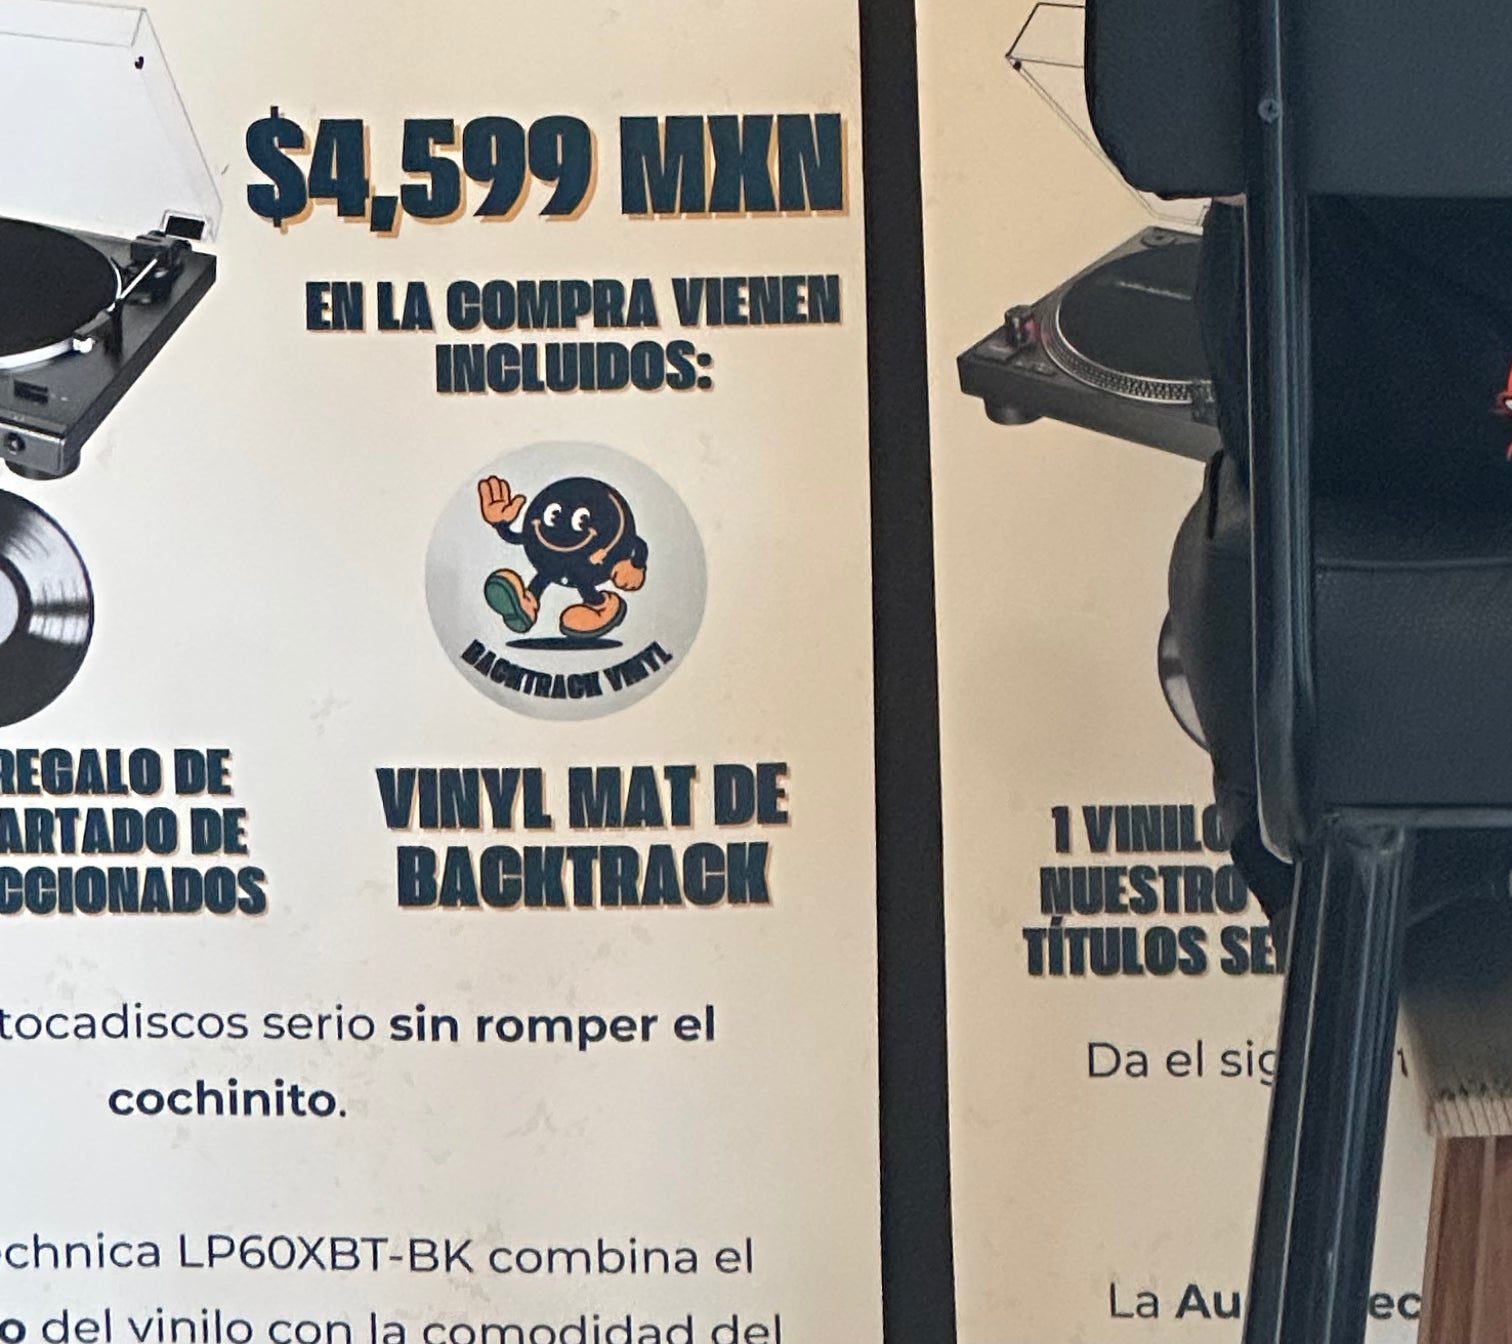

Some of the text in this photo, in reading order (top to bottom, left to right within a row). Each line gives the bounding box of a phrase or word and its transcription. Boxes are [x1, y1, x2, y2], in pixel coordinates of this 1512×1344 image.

[245, 106, 845, 234] $4,599 MXN
[305, 274, 841, 331] EN LA COMPRA VIENEN
[435, 340, 714, 394] INCLUIDOS:
[460, 638, 673, 700] BACKTRACK VINYL
[174, 748, 232, 795] DE
[376, 761, 790, 832] VINYL MAT DE
[191, 807, 248, 854] DE
[1051, 805, 1070, 853] 1
[397, 841, 771, 908] BACKTRACK
[1039, 864, 1250, 915] NUESTRO
[1022, 916, 1208, 977] TÍTULOS
[0, 1003, 716, 1052] tocadiscos serio sin romper el
[1088, 1039, 1203, 1078] Da el
[108, 1079, 348, 1119] cochinito.
[0, 1232, 753, 1276] chnica LP60XBT-BK combina el
[1110, 1281, 1159, 1319] La
[41, 1309, 111, 1344] del
[128, 1309, 254, 1344] vinilo
[267, 1316, 354, 1344] con
[370, 1312, 406, 1344] la
[422, 1313, 695, 1344] comodidad
[712, 1313, 782, 1344] del
